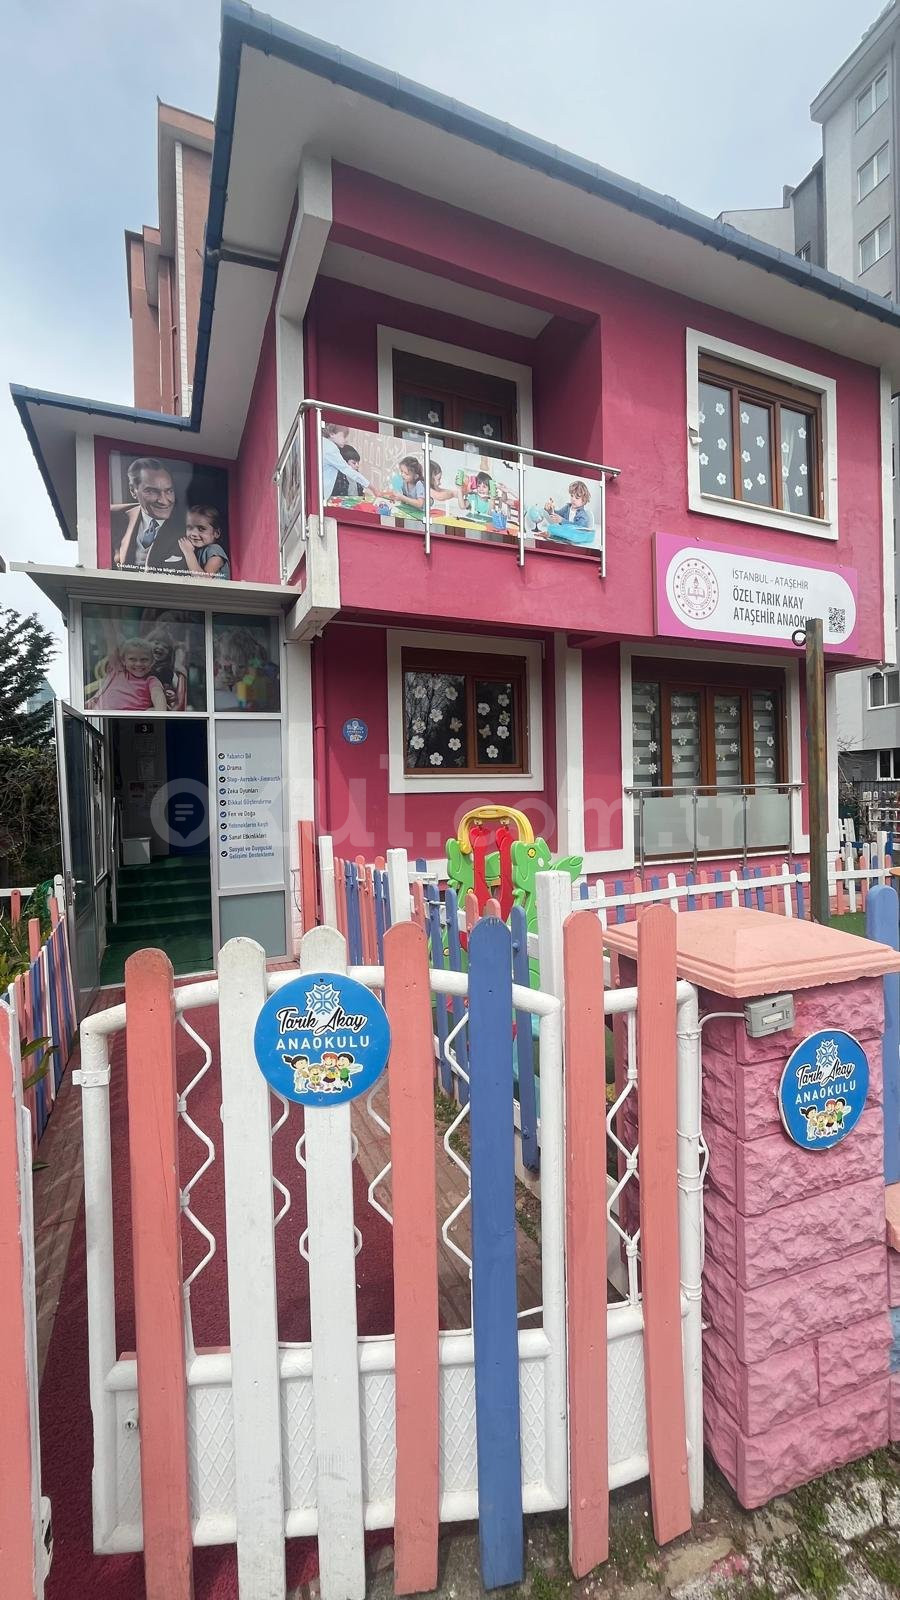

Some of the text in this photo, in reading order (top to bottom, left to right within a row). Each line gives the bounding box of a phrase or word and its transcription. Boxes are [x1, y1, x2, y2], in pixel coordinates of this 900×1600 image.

[732, 568, 768, 584] İSTANBUL
[774, 576, 809, 590] ATAŞEHİR
[732, 585, 804, 610] ÖZEL TARIK AKAY
[733, 607, 813, 628] ATAŞEHİR ANAOK
[244, 810, 256, 818] Doğa
[315, 1007, 367, 1035] Akay
[276, 1035, 370, 1051] ANAOKULU
[821, 1060, 854, 1084] Akay
[795, 1080, 856, 1104] ANAOKULU
